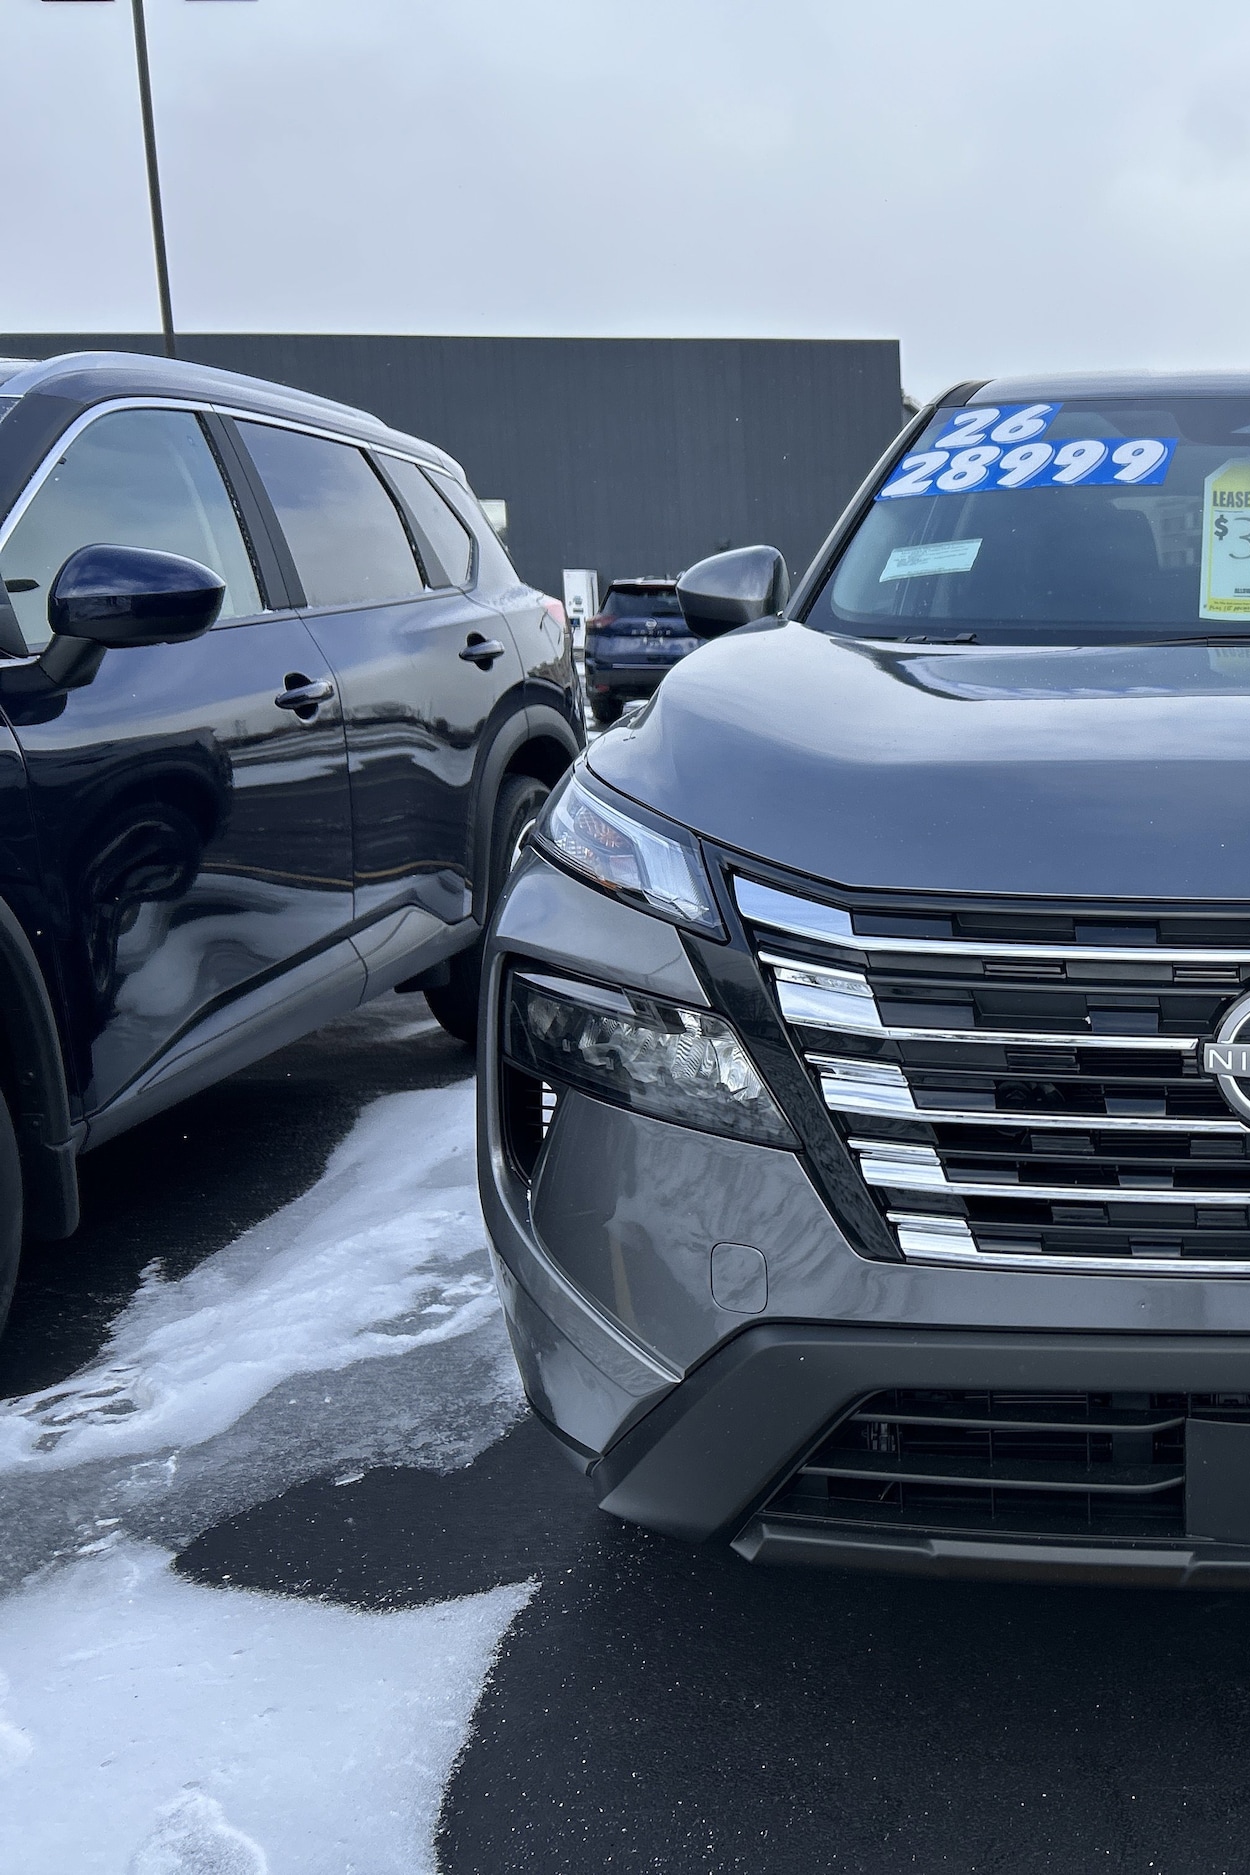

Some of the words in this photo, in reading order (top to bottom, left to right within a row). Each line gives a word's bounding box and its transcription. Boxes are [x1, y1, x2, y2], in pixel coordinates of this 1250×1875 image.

[934, 403, 1053, 449] 26
[880, 439, 1169, 498] 28999
[1212, 490, 1250, 508] LEASE
[1214, 514, 1229, 541] $
